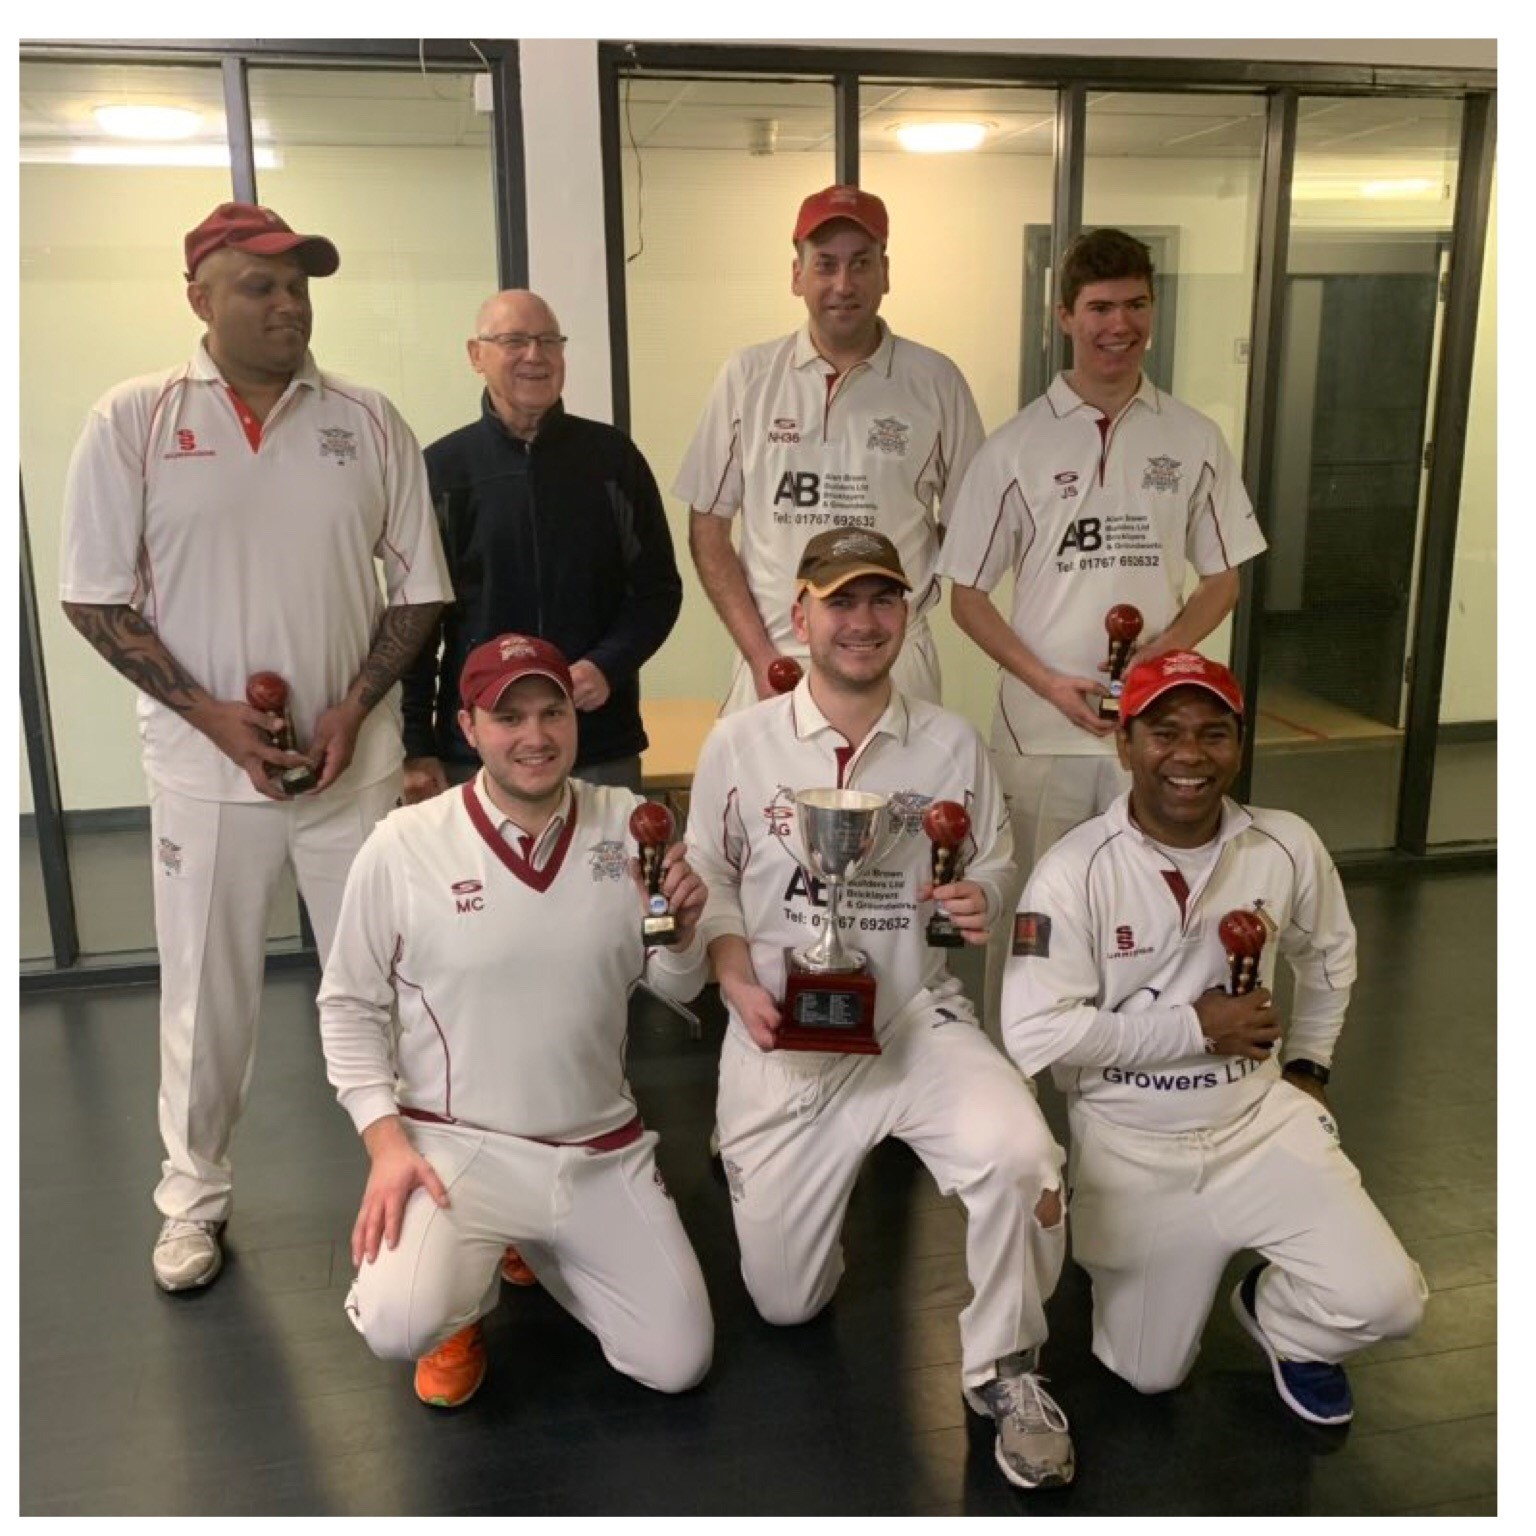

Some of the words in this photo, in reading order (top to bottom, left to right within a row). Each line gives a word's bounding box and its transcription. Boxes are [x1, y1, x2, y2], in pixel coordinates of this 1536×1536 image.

[772, 470, 821, 508] AB
[1057, 517, 1102, 557] AB
[455, 896, 485, 915] MC
[859, 916, 910, 931] 692632
[1102, 1065, 1218, 1091] Growers
